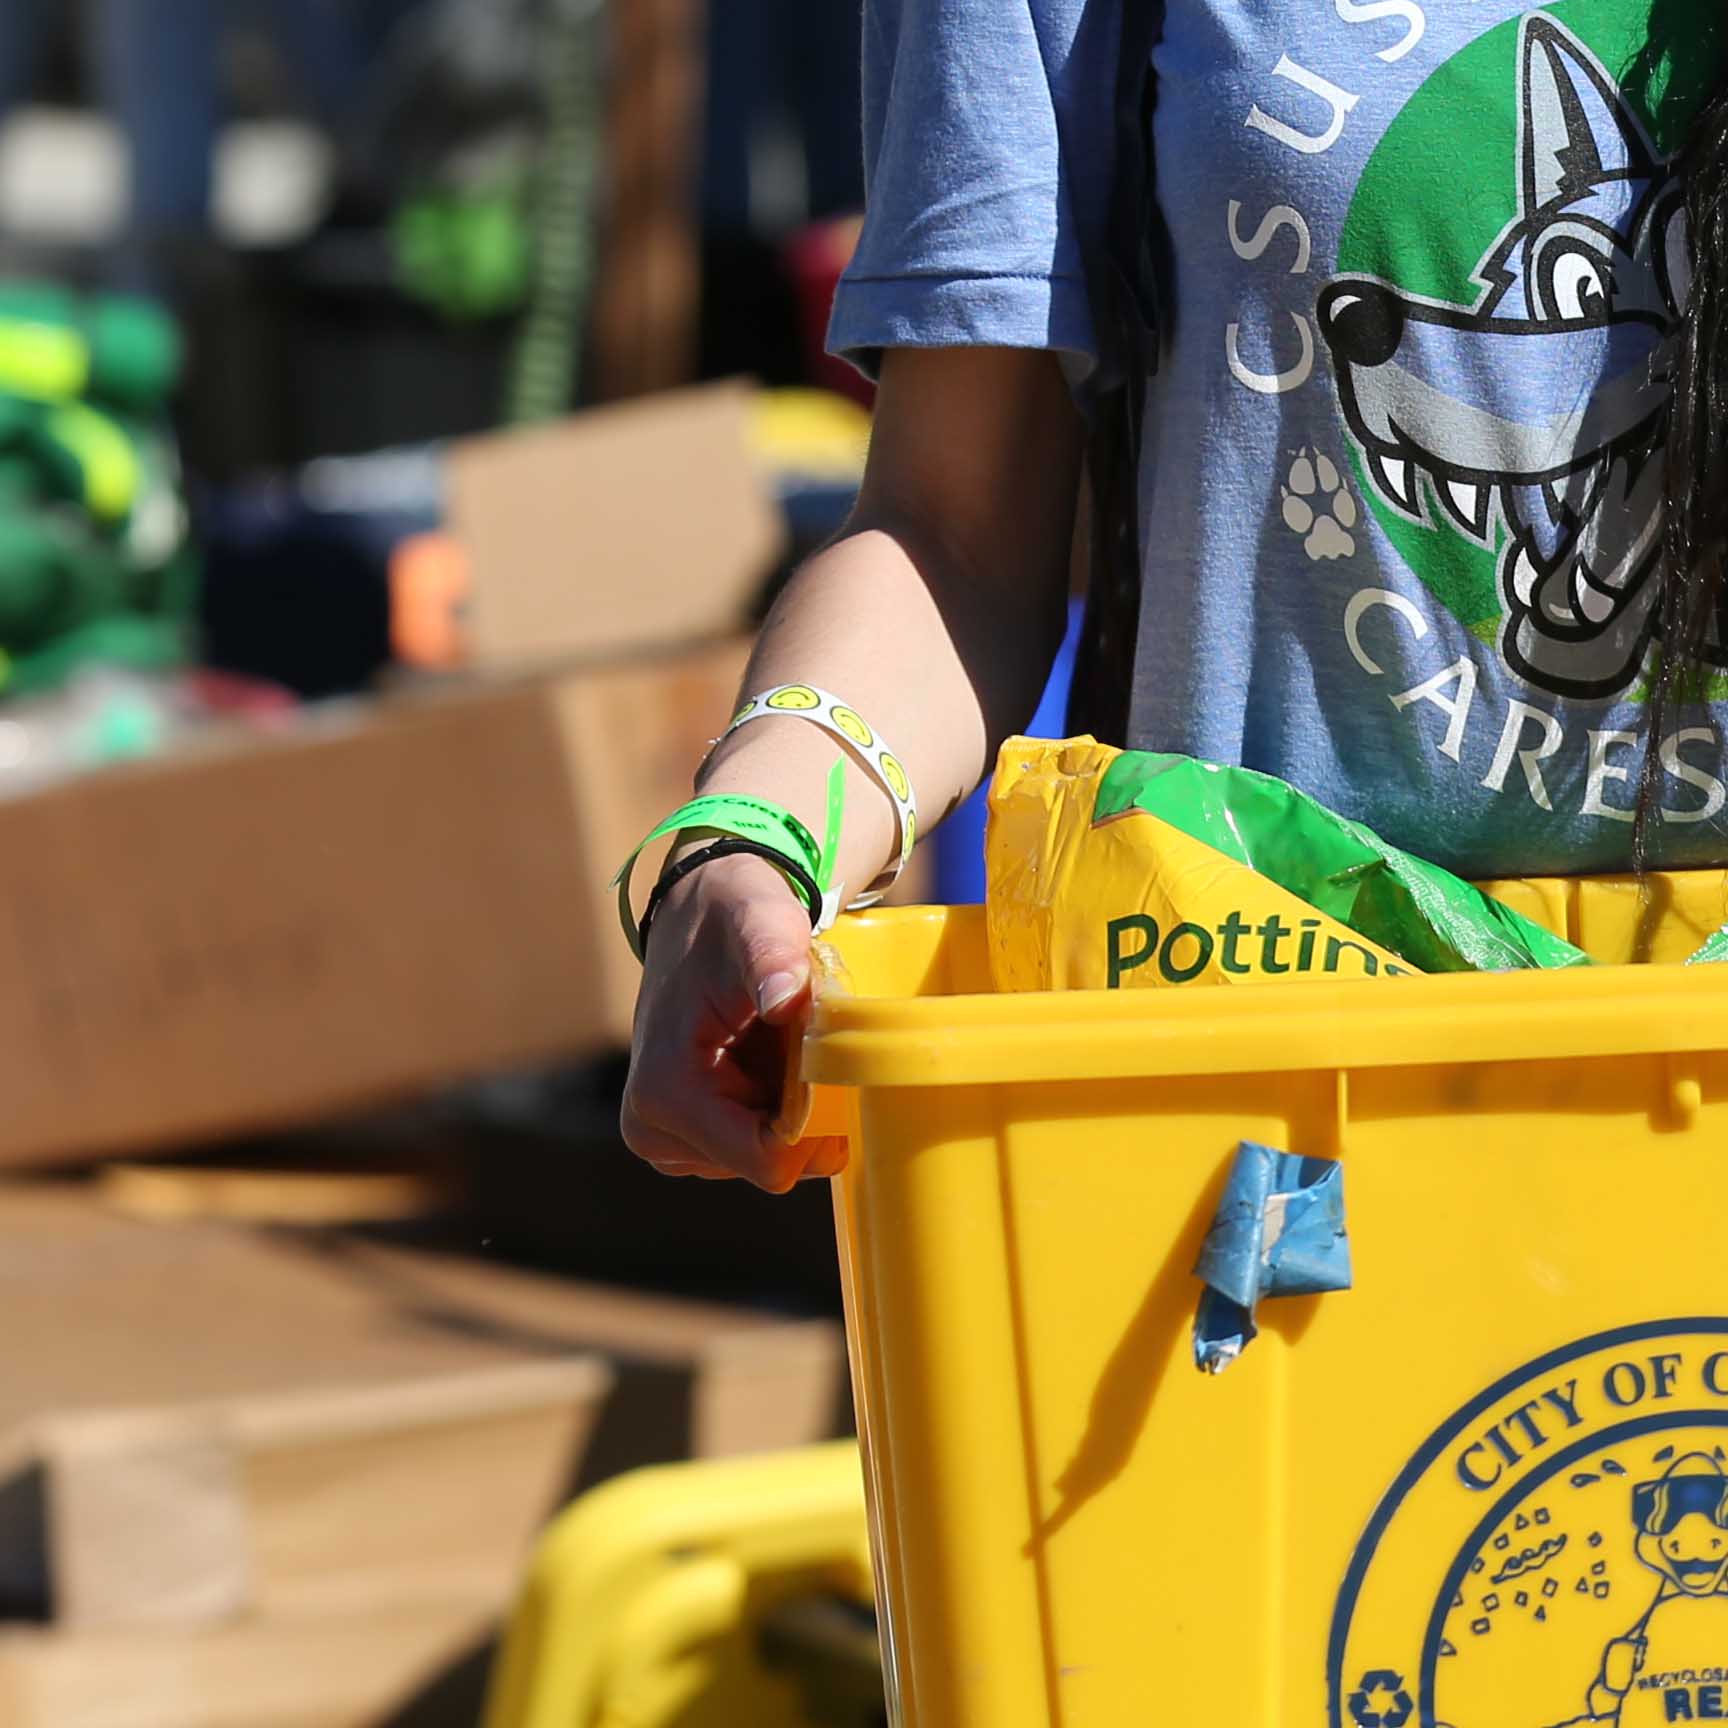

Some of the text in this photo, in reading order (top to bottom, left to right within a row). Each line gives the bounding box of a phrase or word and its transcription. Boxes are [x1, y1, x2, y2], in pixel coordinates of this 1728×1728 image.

[1344, 588, 1727, 823] CARES
[1106, 910, 1415, 990] Pottin
[1456, 1379, 1584, 1492] CITY
[1602, 1353, 1682, 1407] OF
